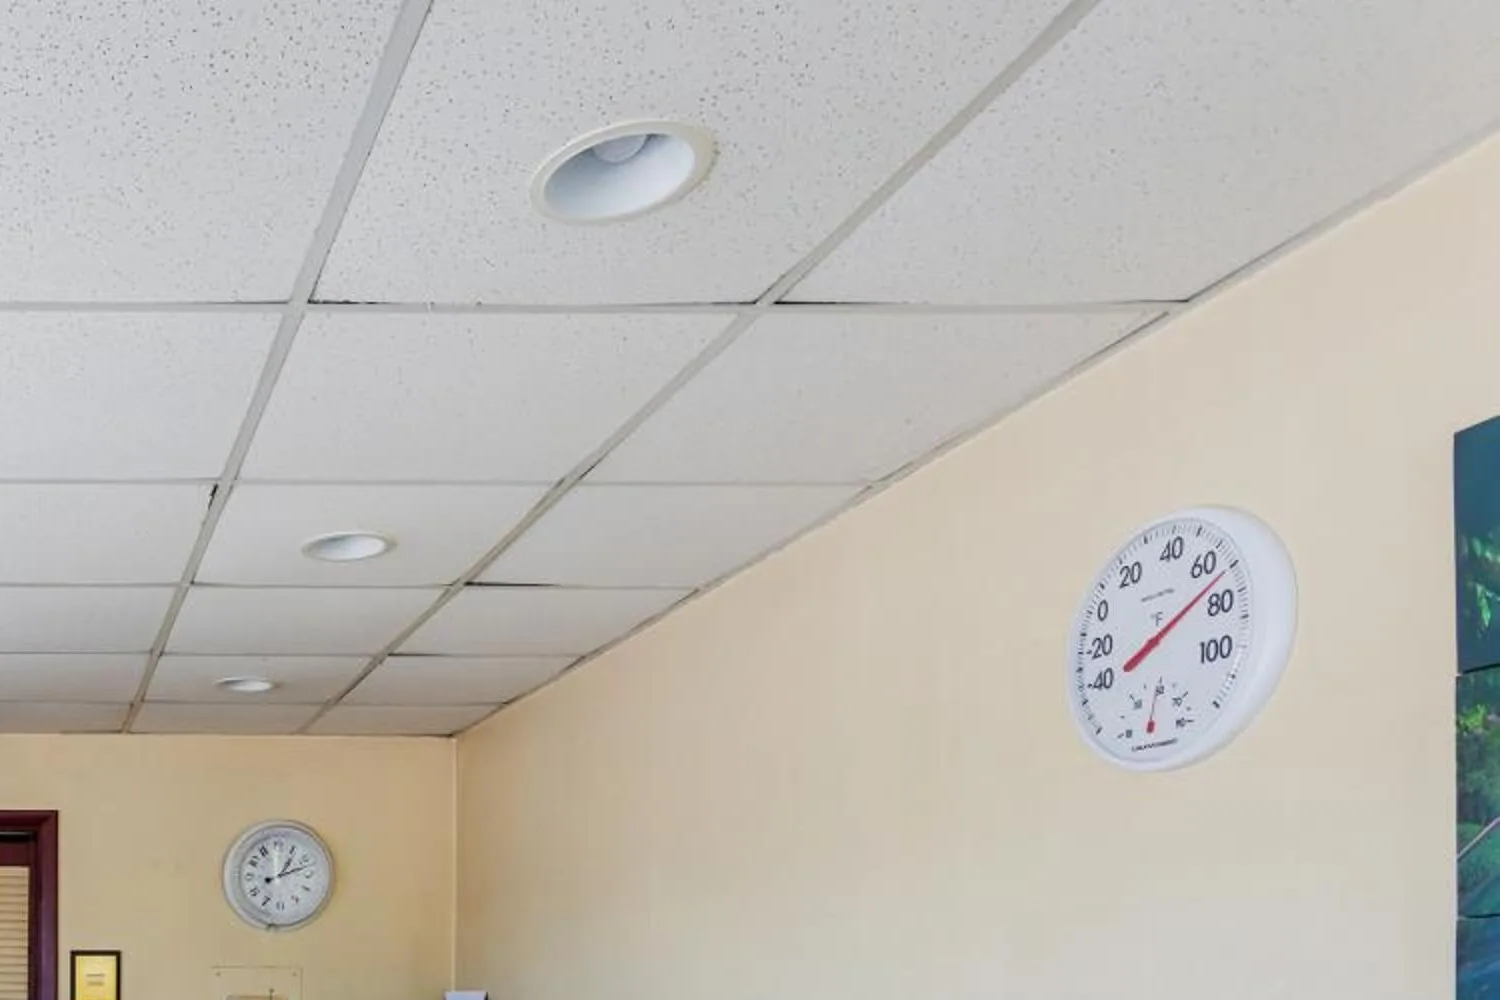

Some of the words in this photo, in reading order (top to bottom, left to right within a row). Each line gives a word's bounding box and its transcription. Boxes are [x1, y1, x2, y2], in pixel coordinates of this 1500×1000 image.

[1159, 536, 1185, 562] 40
[1119, 562, 1143, 588] 20
[1190, 551, 1217, 578] 60
[1097, 600, 1109, 621] 0
[1207, 589, 1234, 616] 80
[1086, 634, 1113, 660] -20
[1200, 635, 1233, 663] 100
[1087, 667, 1115, 690] -40
